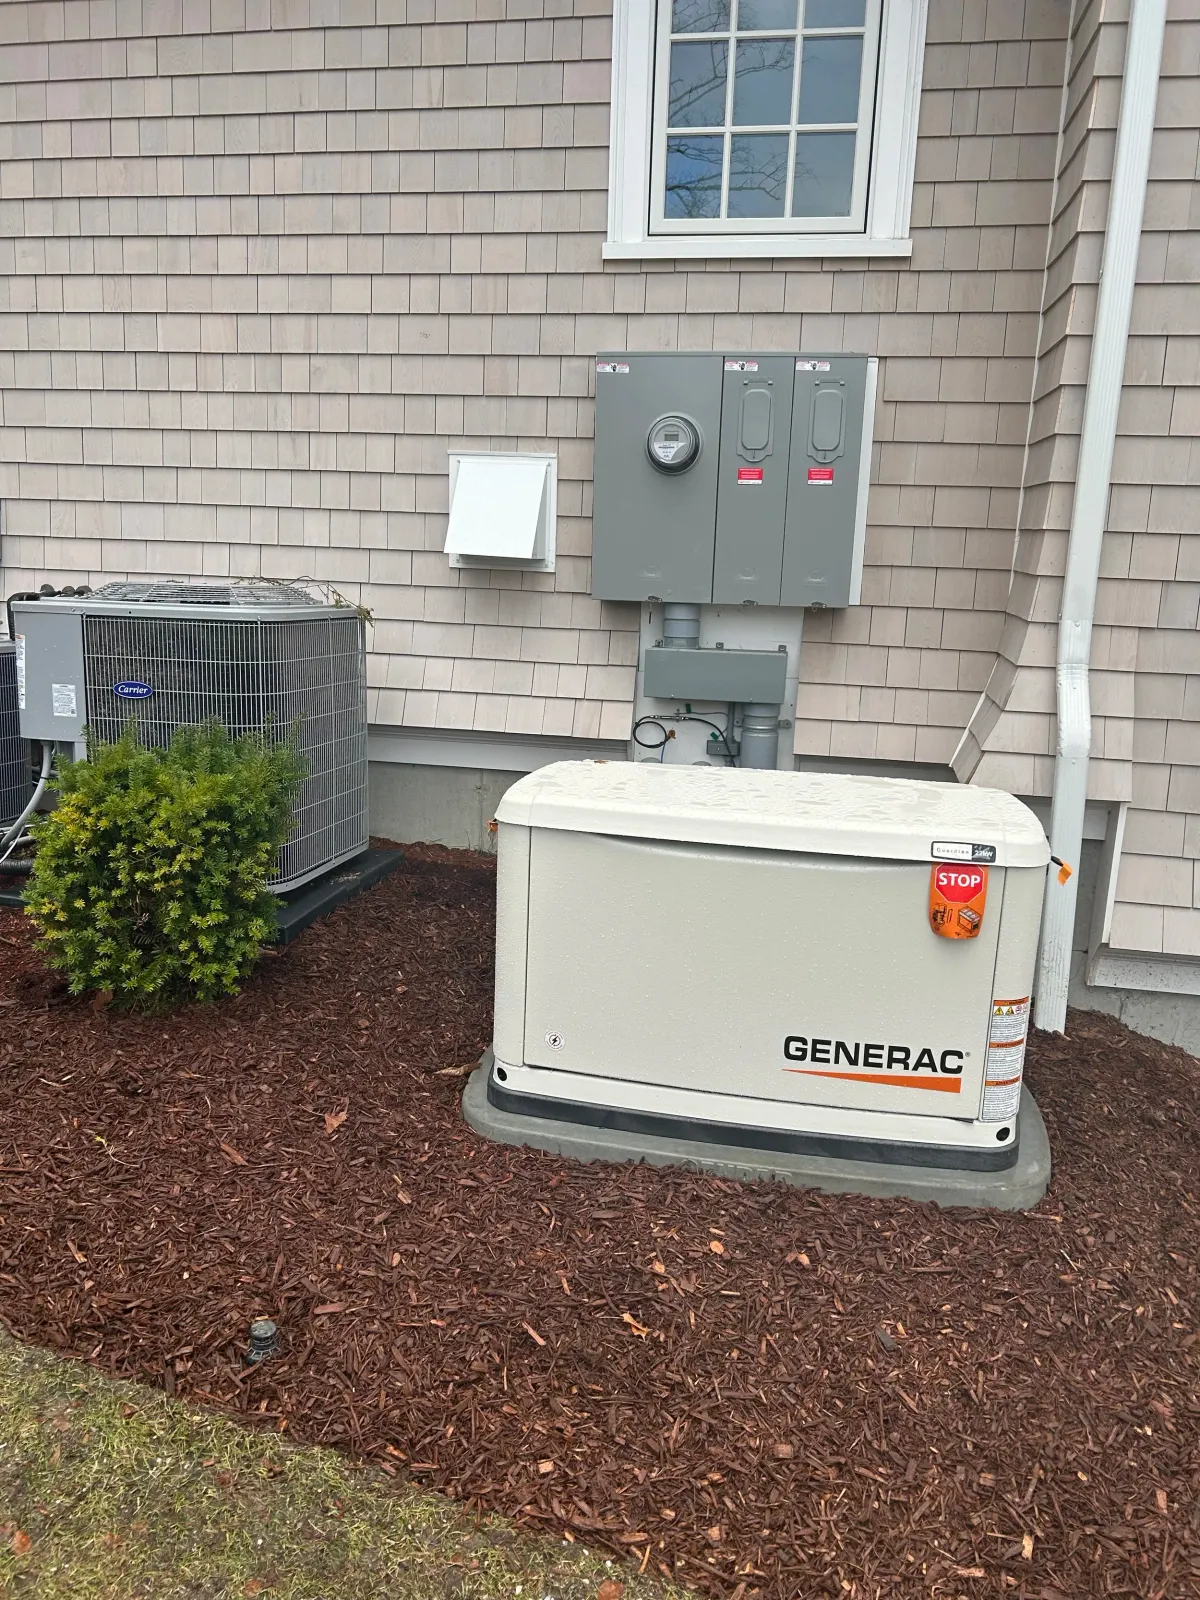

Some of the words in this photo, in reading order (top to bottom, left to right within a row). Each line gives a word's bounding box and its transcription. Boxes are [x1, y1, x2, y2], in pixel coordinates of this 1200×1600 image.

[118, 685, 149, 694] Carrier
[936, 847, 970, 855] Guardian
[938, 872, 981, 888] STOP
[783, 1035, 964, 1075] GENERAC
